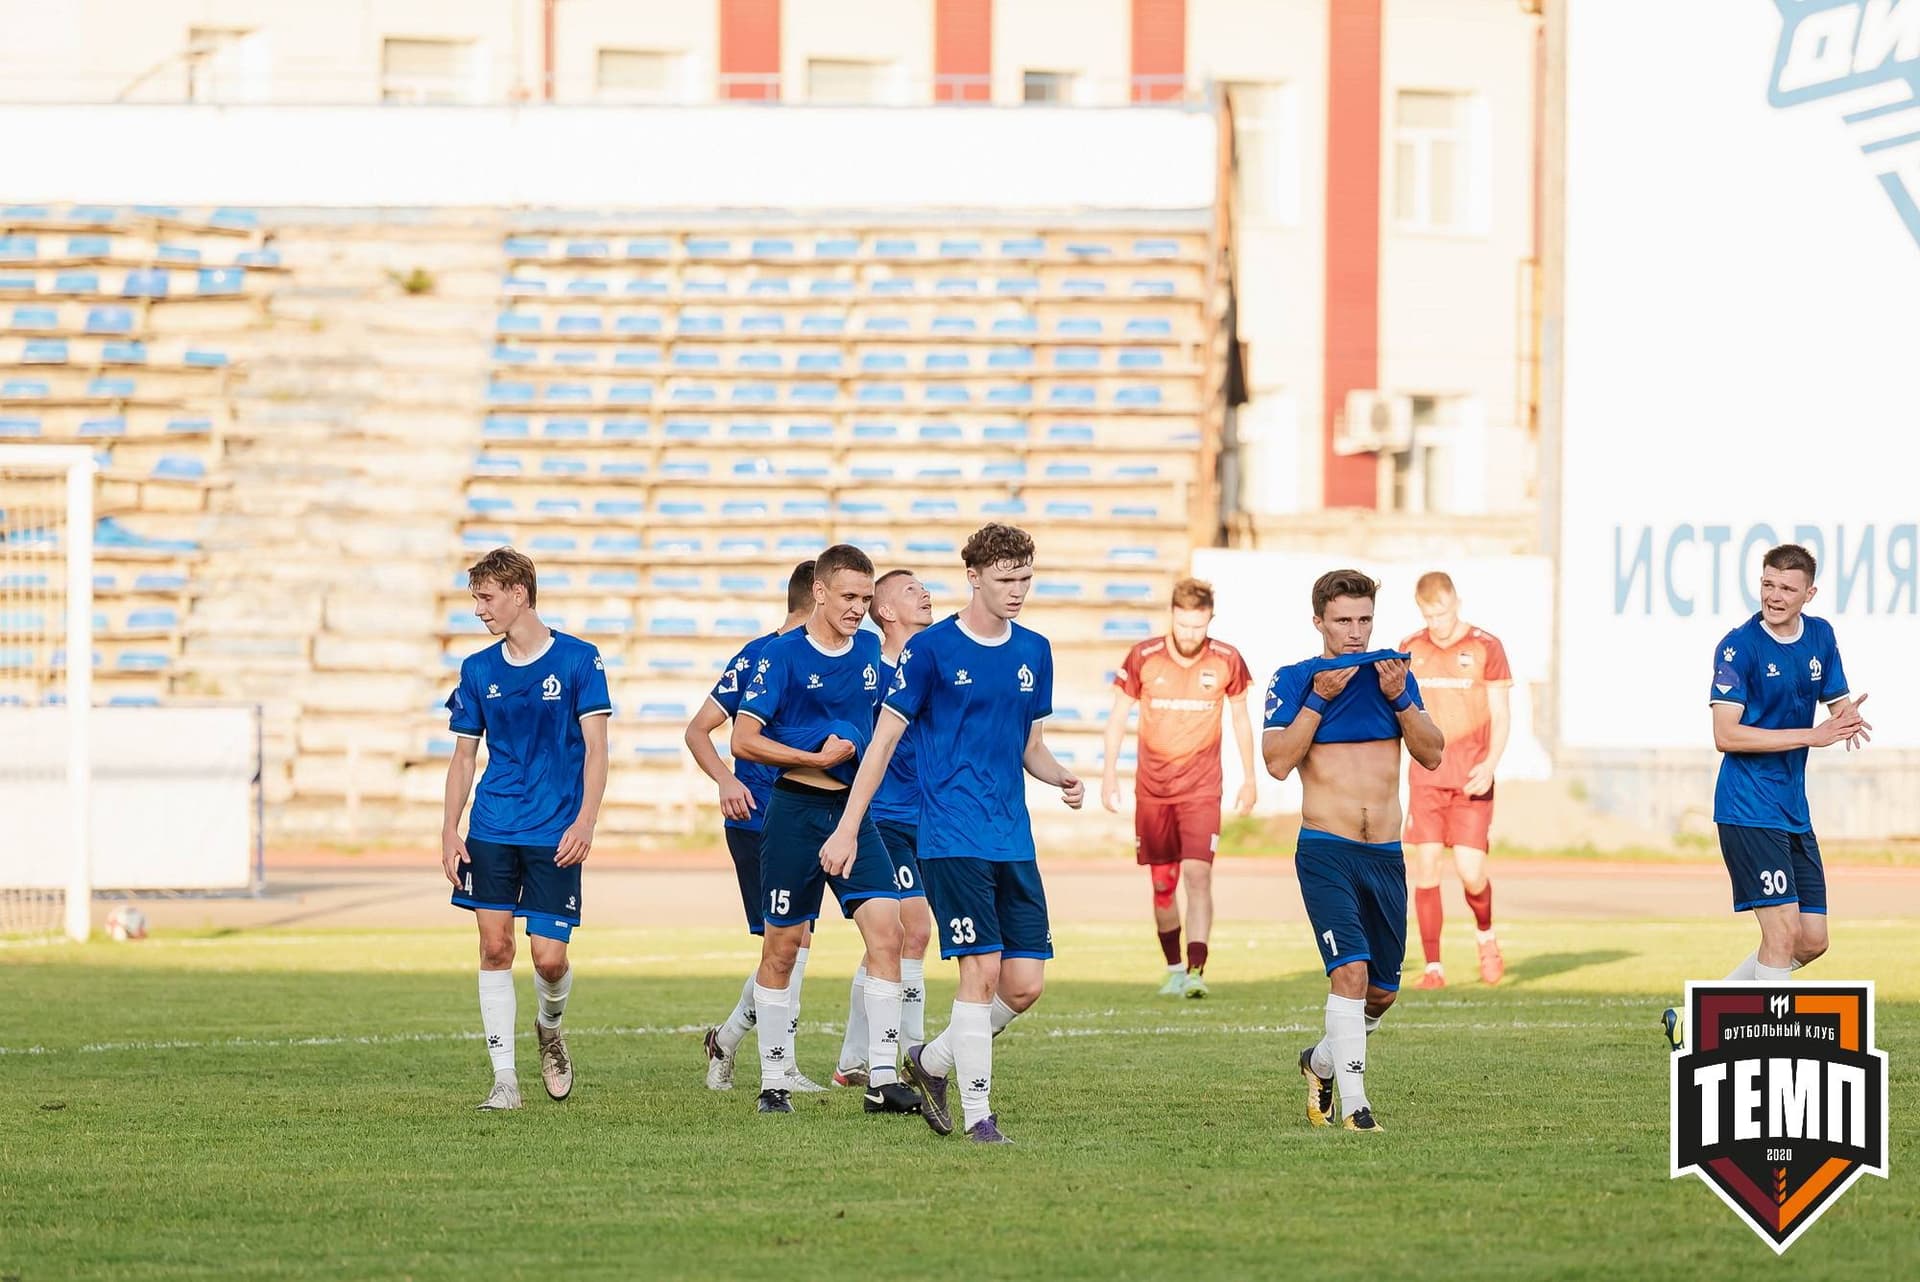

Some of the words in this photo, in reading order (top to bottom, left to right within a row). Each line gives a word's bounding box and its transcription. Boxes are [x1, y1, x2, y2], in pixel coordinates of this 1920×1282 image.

[464, 871, 473, 896] 4
[1760, 869, 1788, 896] 30
[770, 888, 791, 915] 15
[950, 917, 977, 945] 33
[1322, 929, 1339, 957] 7
